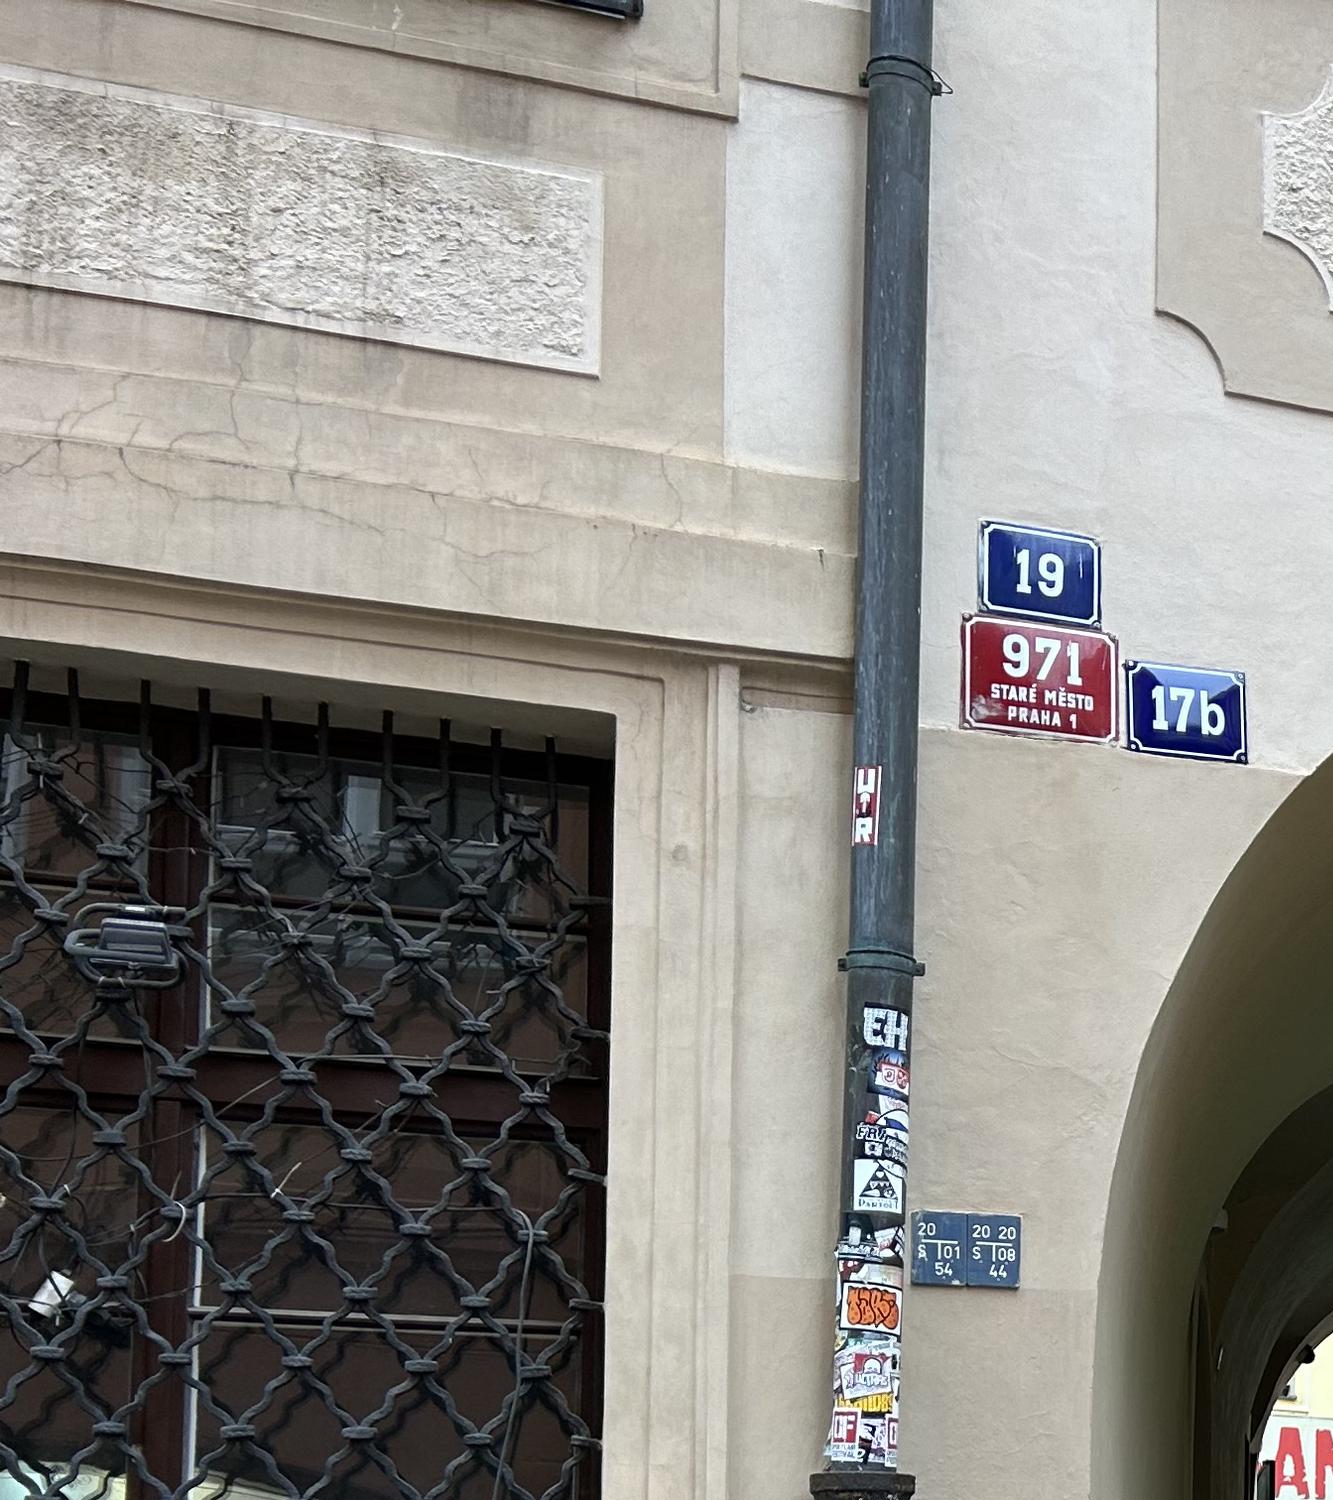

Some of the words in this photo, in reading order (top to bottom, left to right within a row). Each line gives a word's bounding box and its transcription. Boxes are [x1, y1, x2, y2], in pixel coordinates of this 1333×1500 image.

[1015, 548, 1064, 597] 19
[1002, 634, 1083, 686] 971
[990, 682, 1037, 703] STARÉ
[1044, 687, 1094, 711] MĚSTO
[1008, 706, 1061, 727] PRAHA
[1069, 712, 1078, 729] 1
[1151, 684, 1226, 736] 17b
[918, 1222, 936, 1236] 20
[972, 1224, 991, 1239] 20
[998, 1226, 1017, 1240] 20
[943, 1245, 960, 1260] 01
[972, 1246, 981, 1260] S
[998, 1247, 1016, 1261] 08
[934, 1262, 953, 1276] 54
[989, 1264, 1008, 1278] 44
